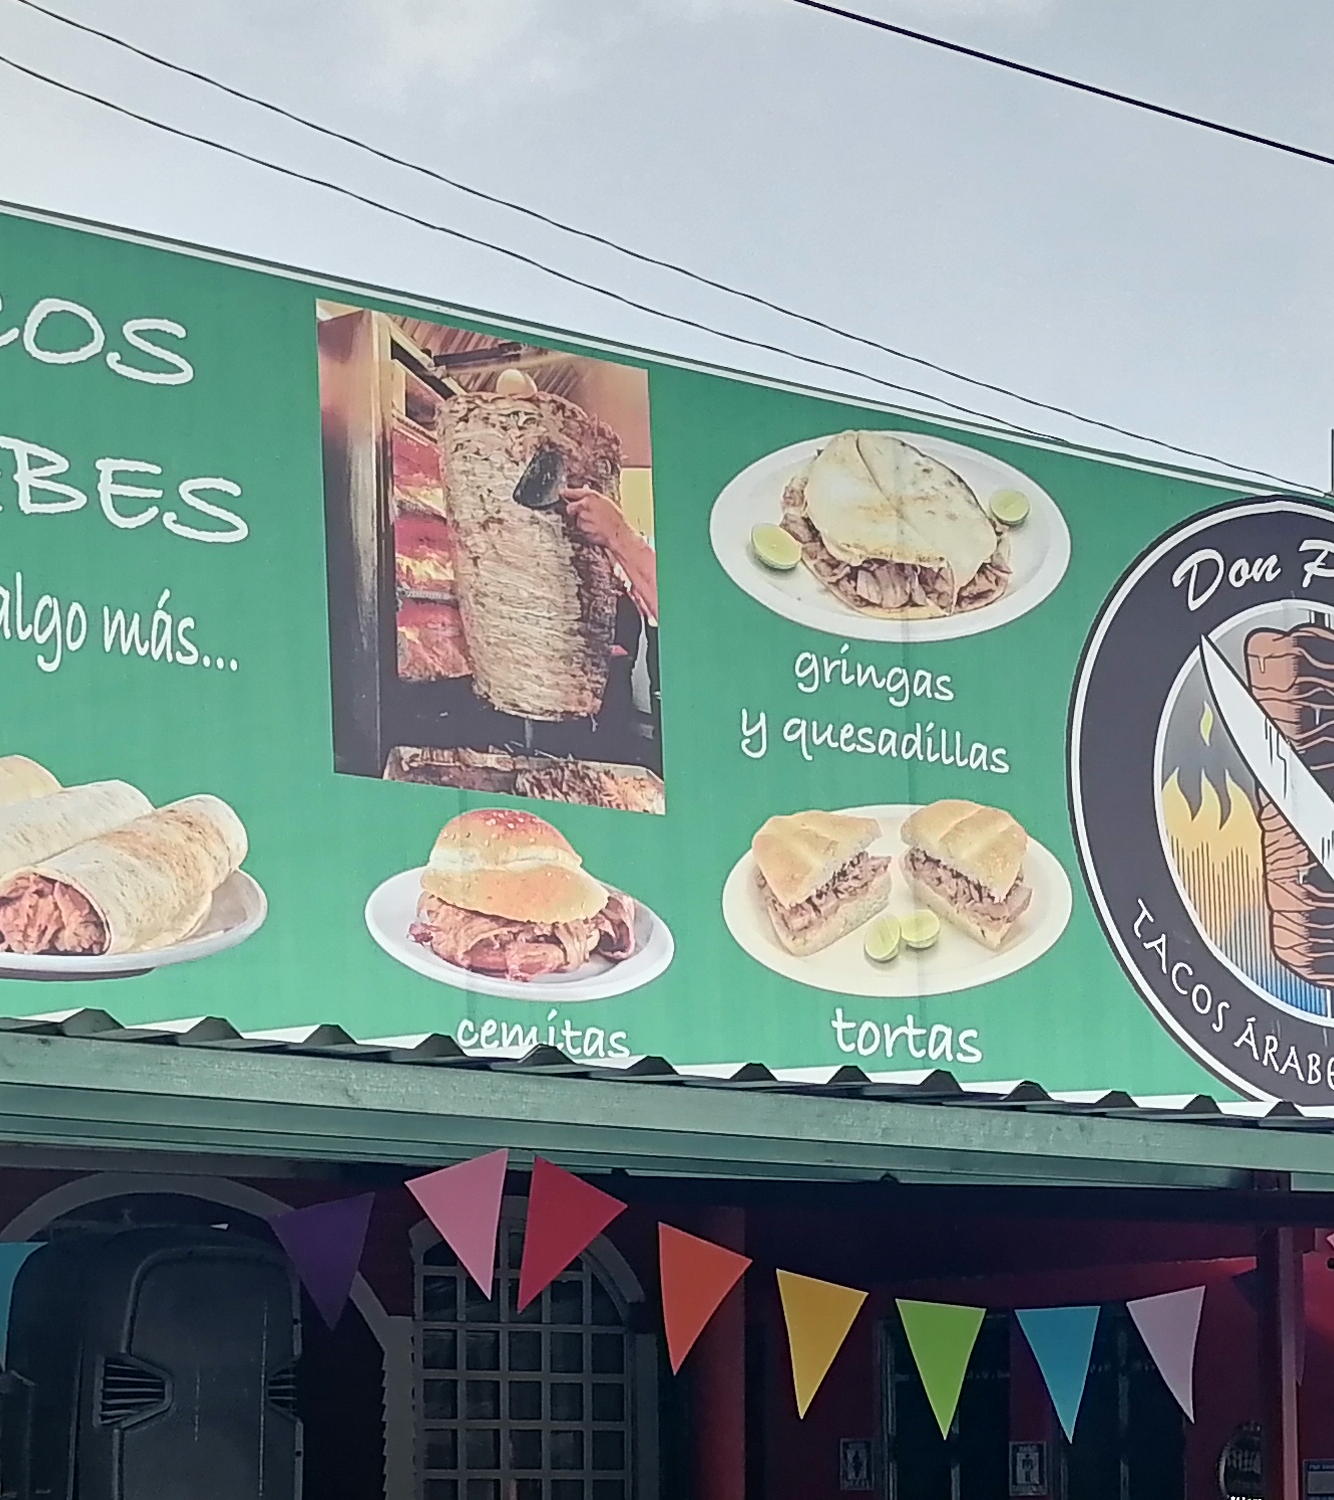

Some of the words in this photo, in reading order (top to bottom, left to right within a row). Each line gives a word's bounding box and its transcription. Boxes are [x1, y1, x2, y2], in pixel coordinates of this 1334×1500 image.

[1172, 547, 1282, 612] Don
[103, 589, 238, 670] más...
[794, 644, 955, 706] gringas
[741, 708, 767, 758] y
[783, 718, 1010, 773] quesadillas
[1134, 898, 1231, 1034] TACOS
[456, 1009, 631, 1059] cemitas
[831, 1008, 984, 1064] tortas
